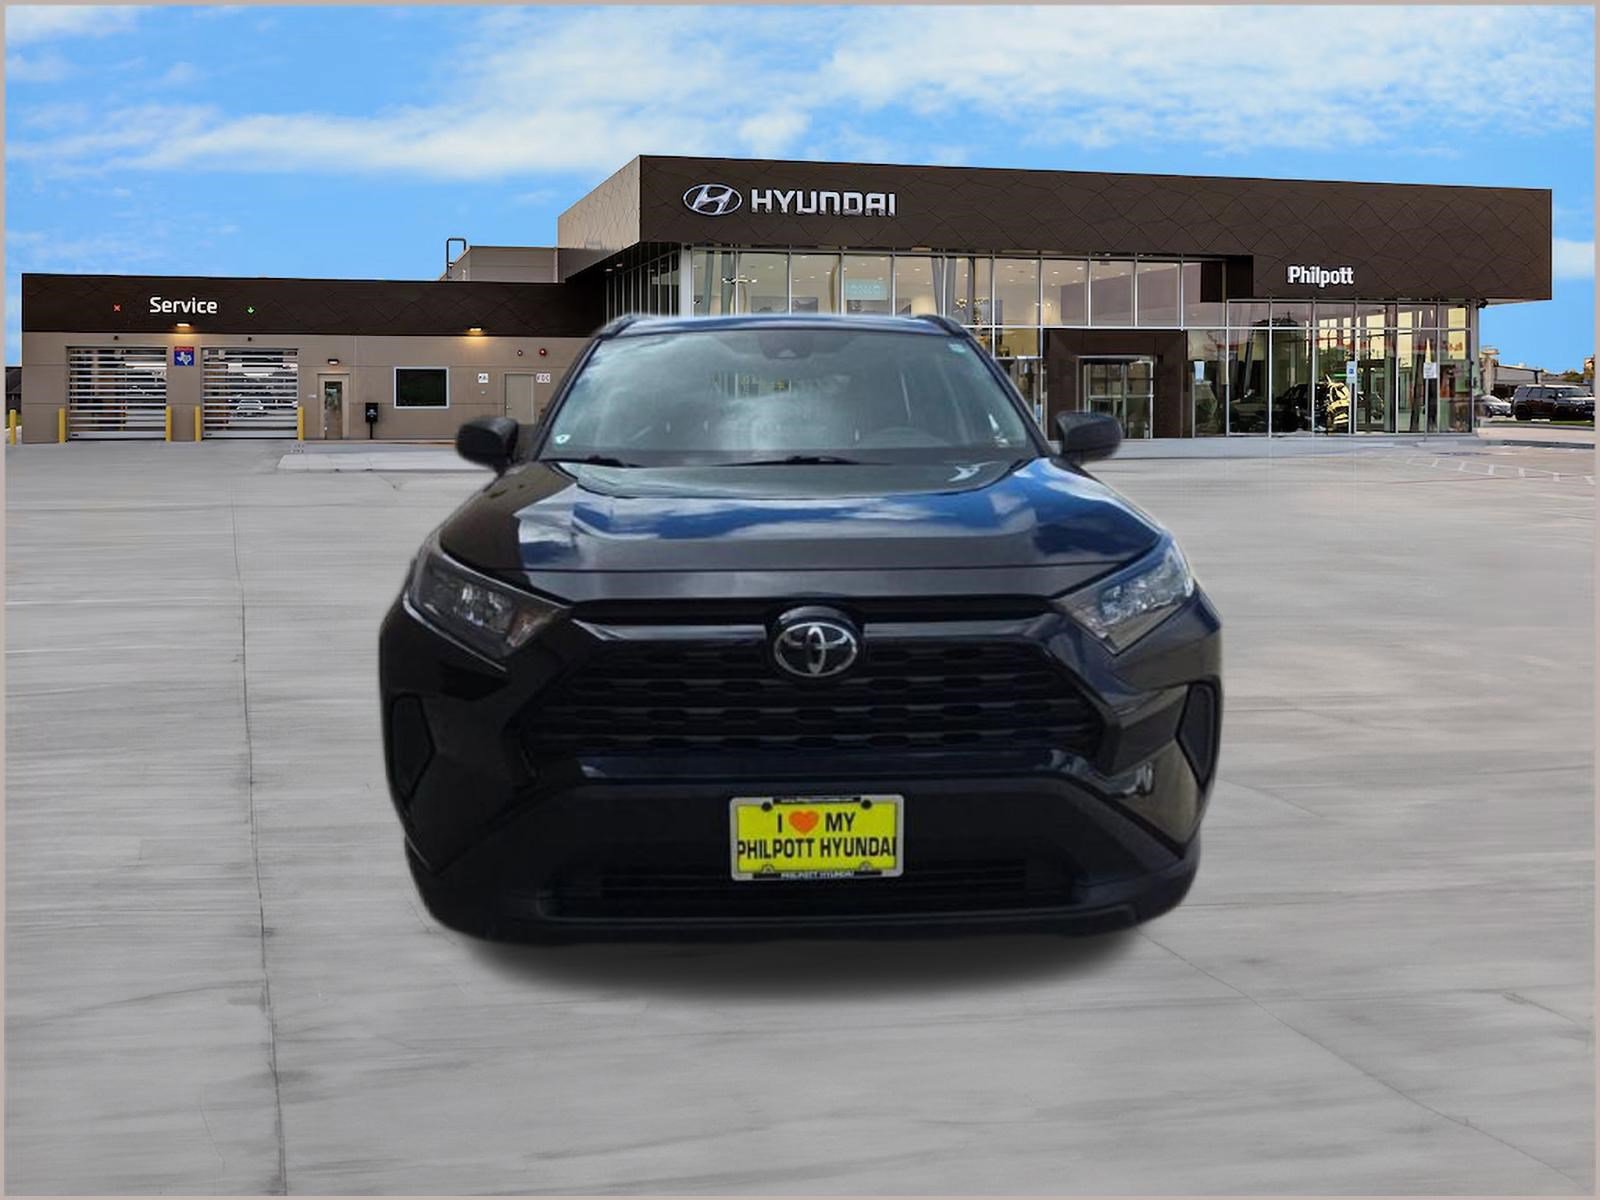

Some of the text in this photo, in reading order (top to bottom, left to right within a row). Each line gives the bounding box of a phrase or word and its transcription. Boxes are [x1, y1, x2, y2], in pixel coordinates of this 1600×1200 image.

[751, 189, 896, 216] HYUNDAI
[1287, 266, 1354, 288] Philpott
[149, 297, 218, 314] Service
[777, 813, 856, 833] I MY
[738, 839, 815, 859] PHILPOTT
